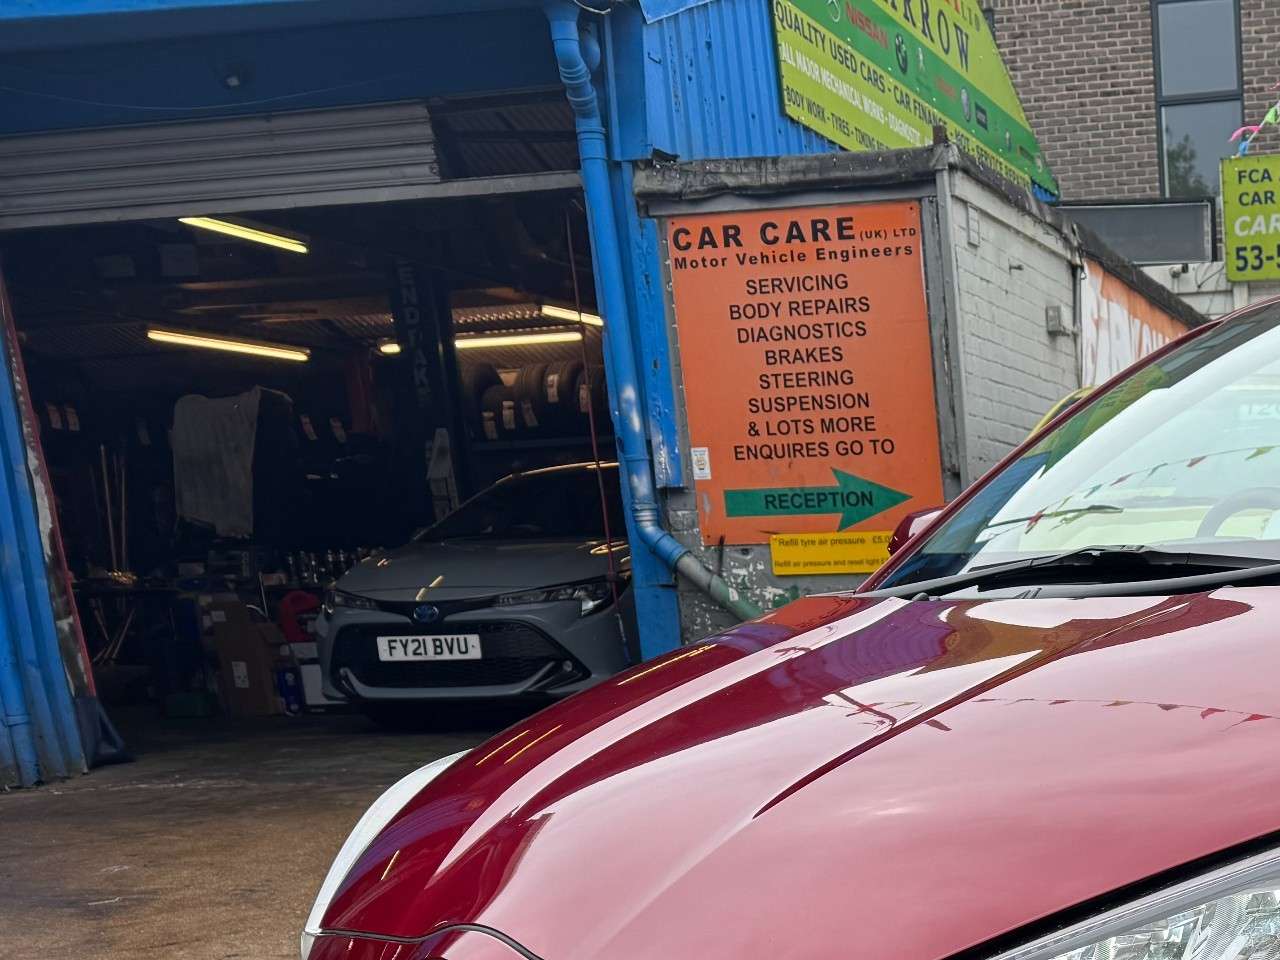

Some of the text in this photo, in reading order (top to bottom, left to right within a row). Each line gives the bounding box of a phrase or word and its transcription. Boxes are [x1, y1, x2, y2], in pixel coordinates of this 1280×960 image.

[775, 2, 825, 52] QUALITY
[829, 38, 857, 73] USED
[860, 61, 885, 93] CARS
[894, 85, 911, 113] CAR
[786, 85, 804, 111] BODY
[806, 97, 826, 123] WORK
[1237, 168, 1273, 184] FCA
[1238, 190, 1276, 207] CAR
[673, 216, 917, 251] CAR CARE (UK) LTD
[674, 244, 913, 270] Motor Vehicle Engineers
[746, 273, 849, 295] SERVICING
[729, 296, 870, 321] BODY REPAIRS
[737, 320, 867, 344] DIAGNOSTICS
[765, 346, 843, 366] BRAKES
[759, 369, 854, 390] STEERING
[748, 392, 870, 414] SUSPENSION
[747, 415, 876, 437] & LOTS MORE
[734, 438, 895, 461] ENQUIRES GO TO
[764, 490, 873, 510] RECEPTION
[779, 537, 799, 547] Refill
[800, 539, 816, 547] tyre
[818, 538, 829, 546] air
[830, 537, 866, 547] pressure
[387, 636, 469, 656] FY21 BVU
